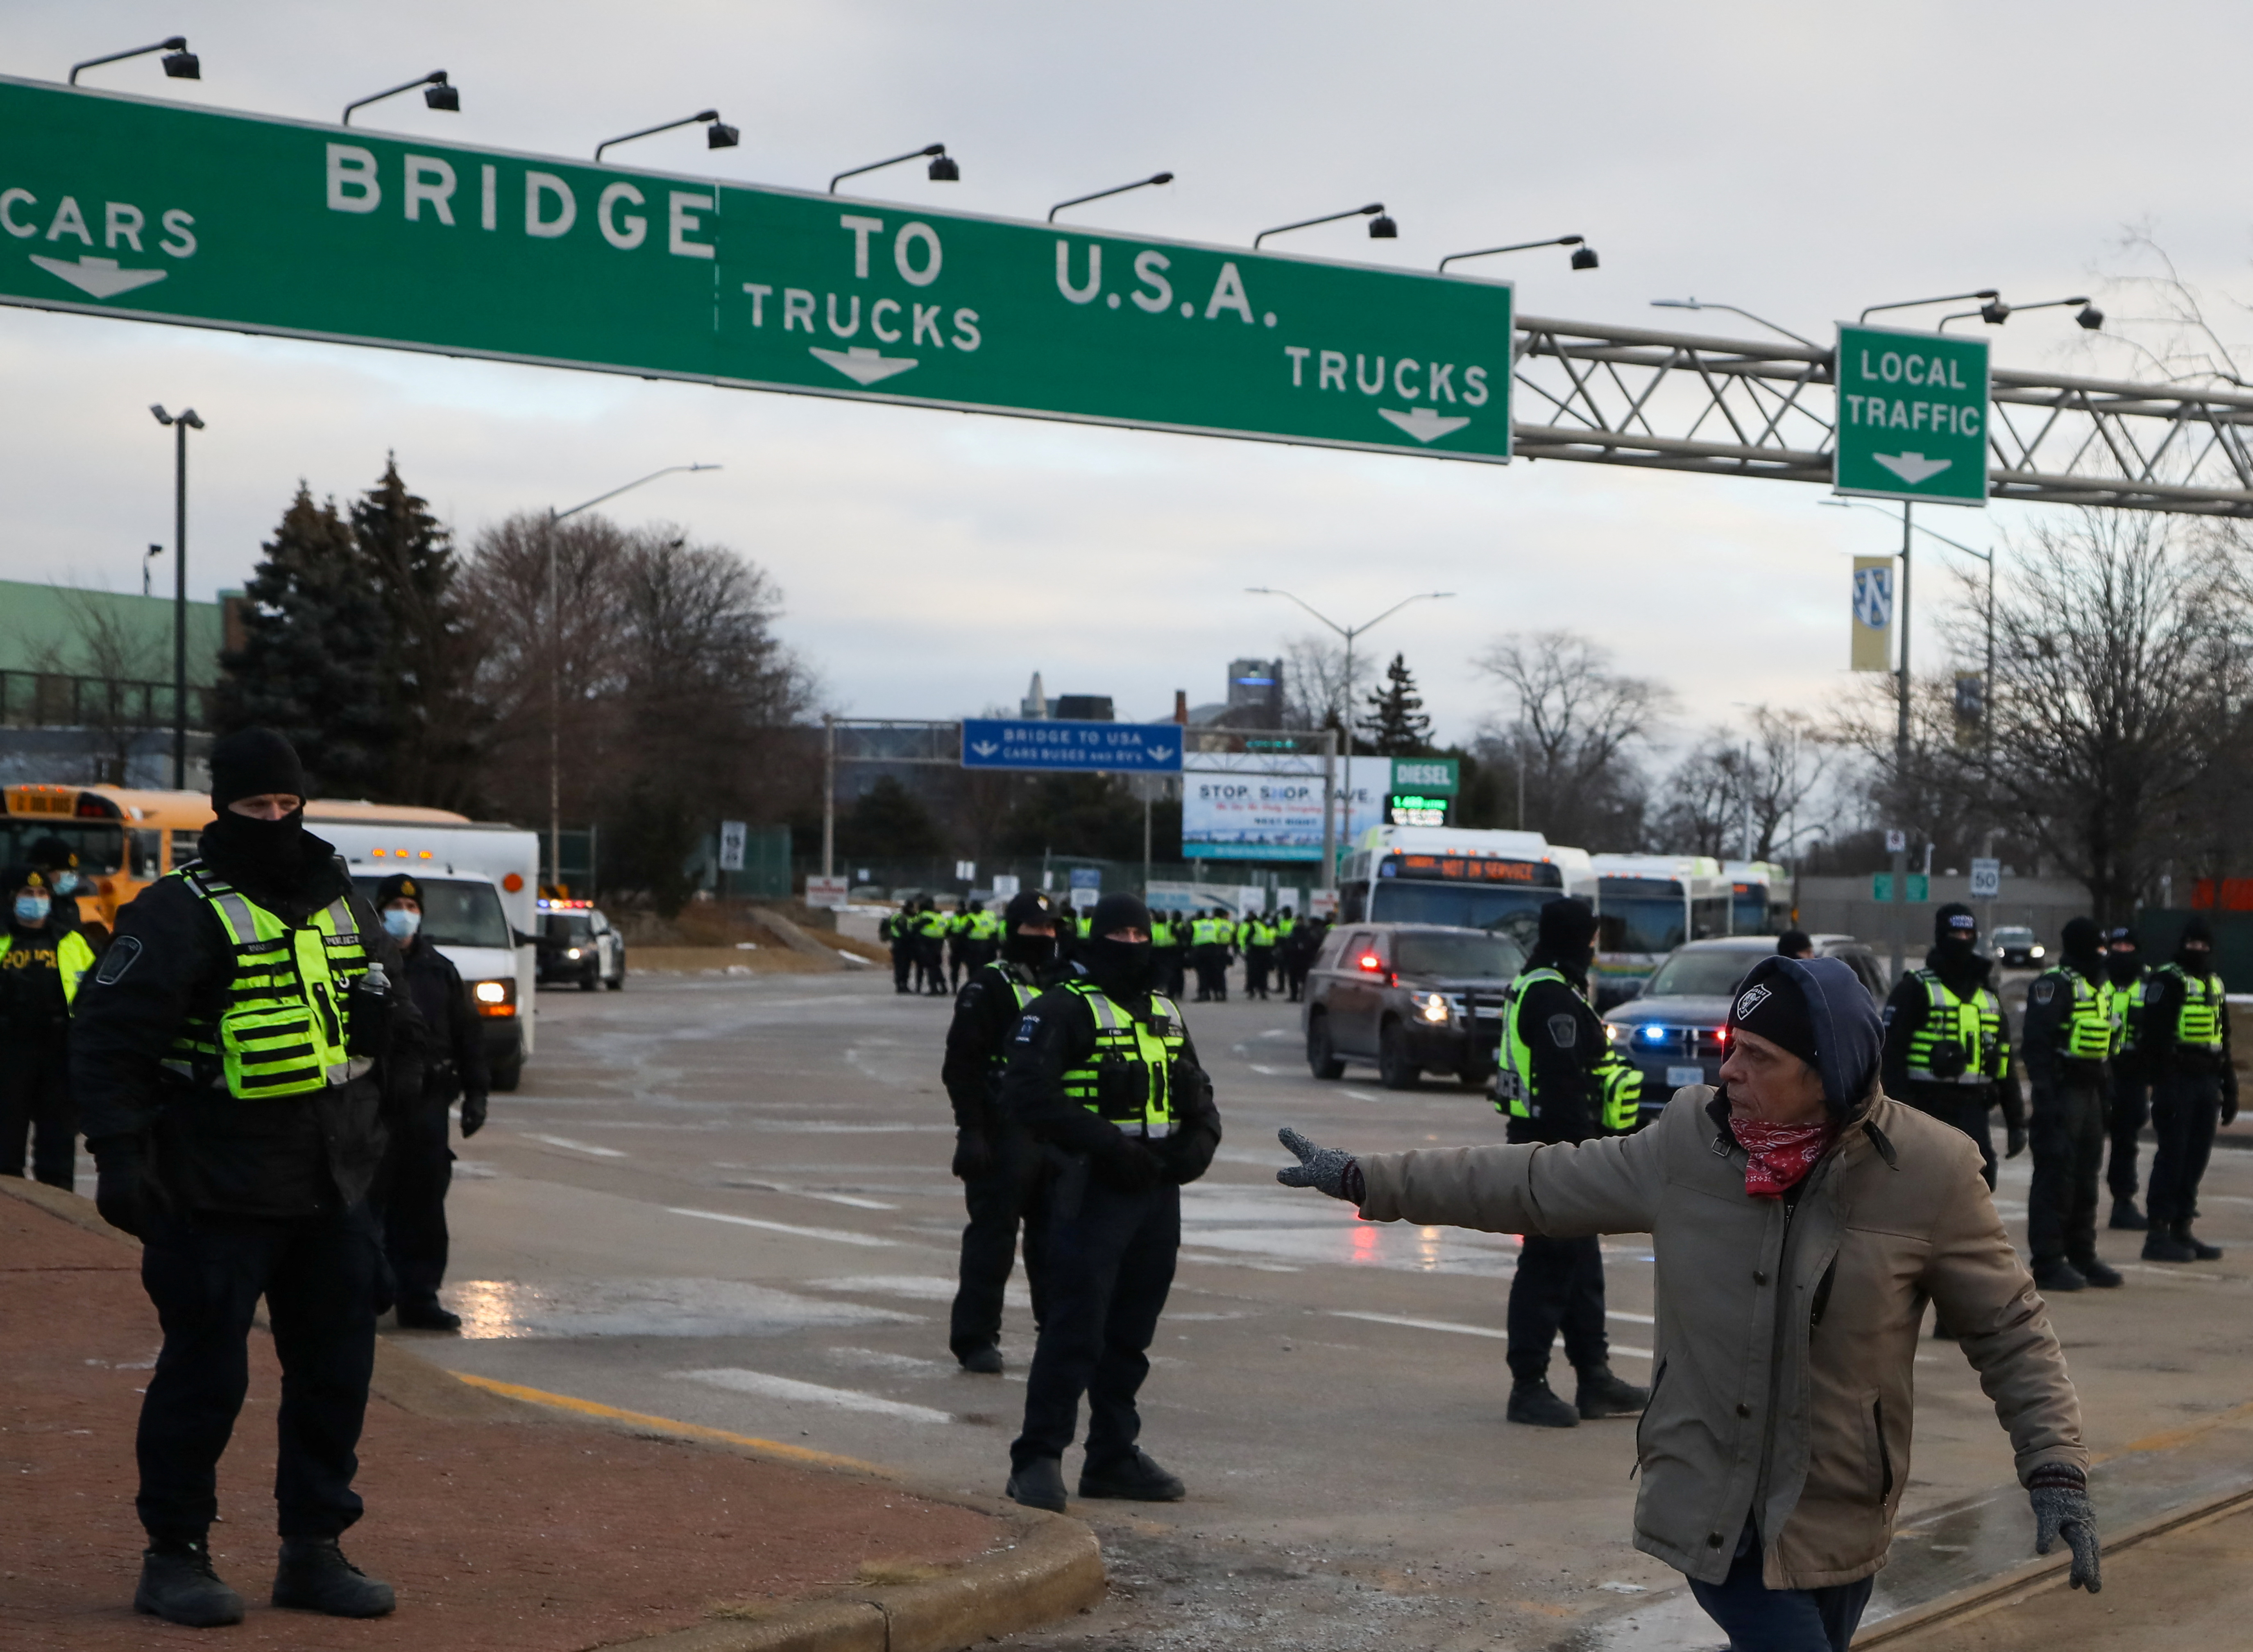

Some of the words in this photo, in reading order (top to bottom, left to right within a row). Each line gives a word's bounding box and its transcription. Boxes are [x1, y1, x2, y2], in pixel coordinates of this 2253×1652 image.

[0, 188, 197, 258] CARS
[326, 143, 716, 259] BRIDGE
[840, 214, 942, 286] TO
[1056, 240, 1277, 327] U.S.A.
[743, 283, 981, 351] TRUCKS
[1285, 346, 1488, 406] TRUCKS
[1861, 349, 1966, 389] LOCAL
[1847, 395, 1979, 436] TRAFFIC
[1003, 747, 1038, 760] CARS
[1041, 747, 1086, 762] BUSES
[1004, 728, 1070, 744] BRIDGE
[1078, 730, 1101, 746] TO
[1107, 731, 1143, 747] USA
[1396, 764, 1451, 785] DIESEL
[1975, 871, 1996, 889] 50
